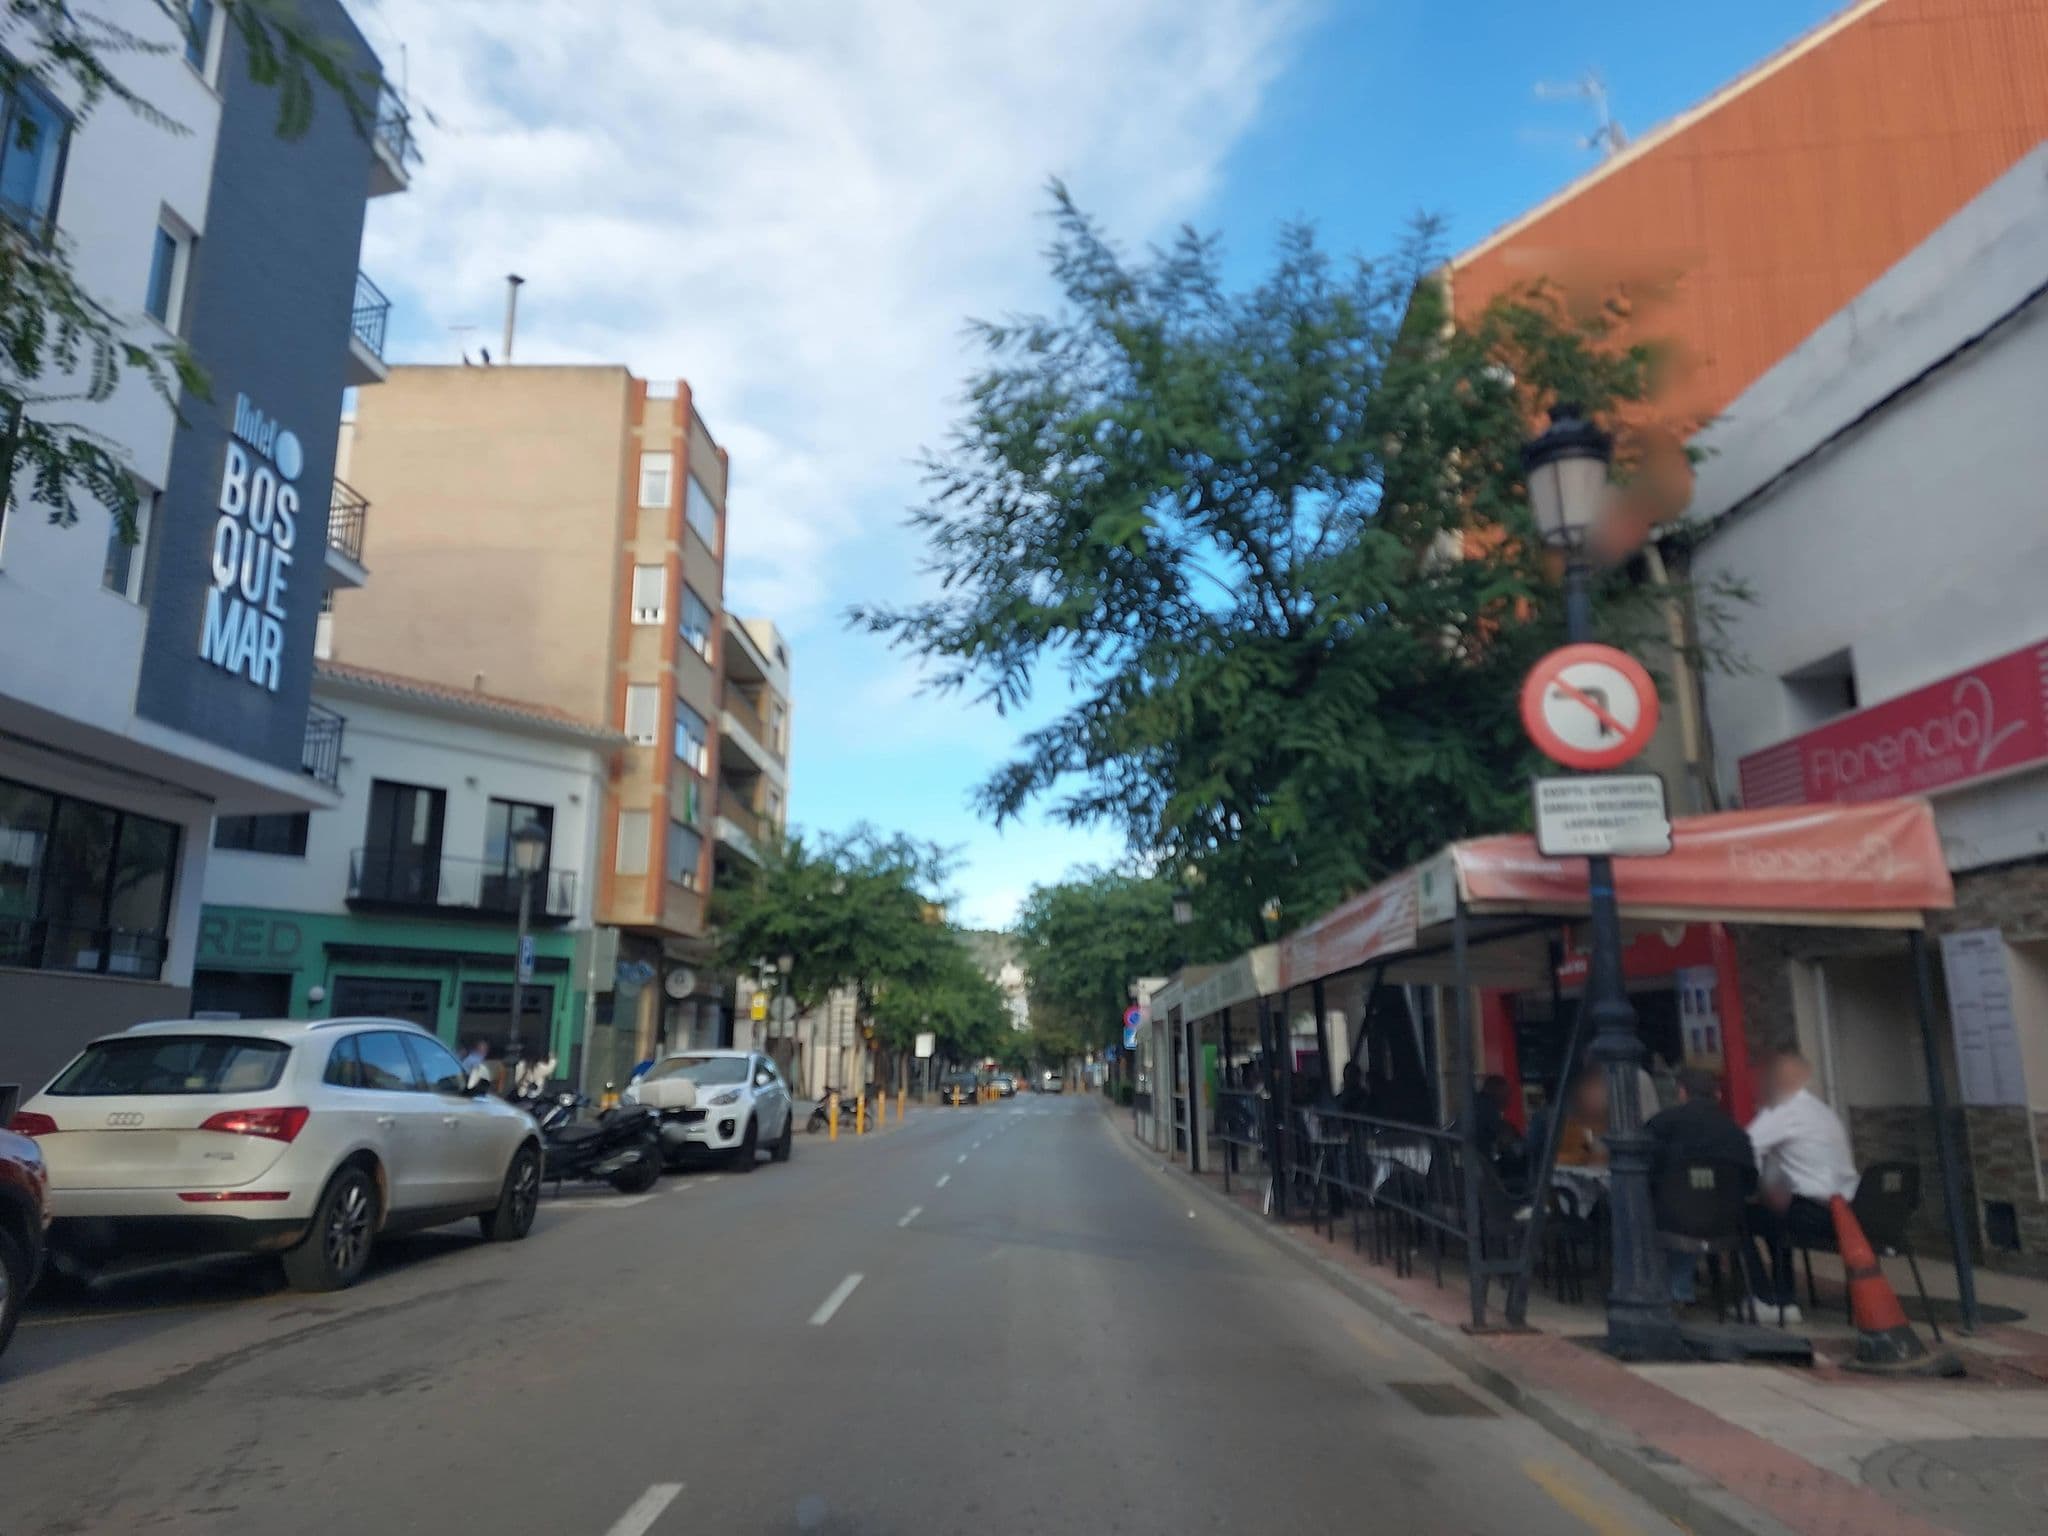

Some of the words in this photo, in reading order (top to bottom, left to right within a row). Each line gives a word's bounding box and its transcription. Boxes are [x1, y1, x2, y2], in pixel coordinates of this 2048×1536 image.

[218, 441, 300, 550] BOS
[211, 514, 294, 620] QUE
[199, 584, 285, 692] MAR
[197, 914, 302, 957] RED
